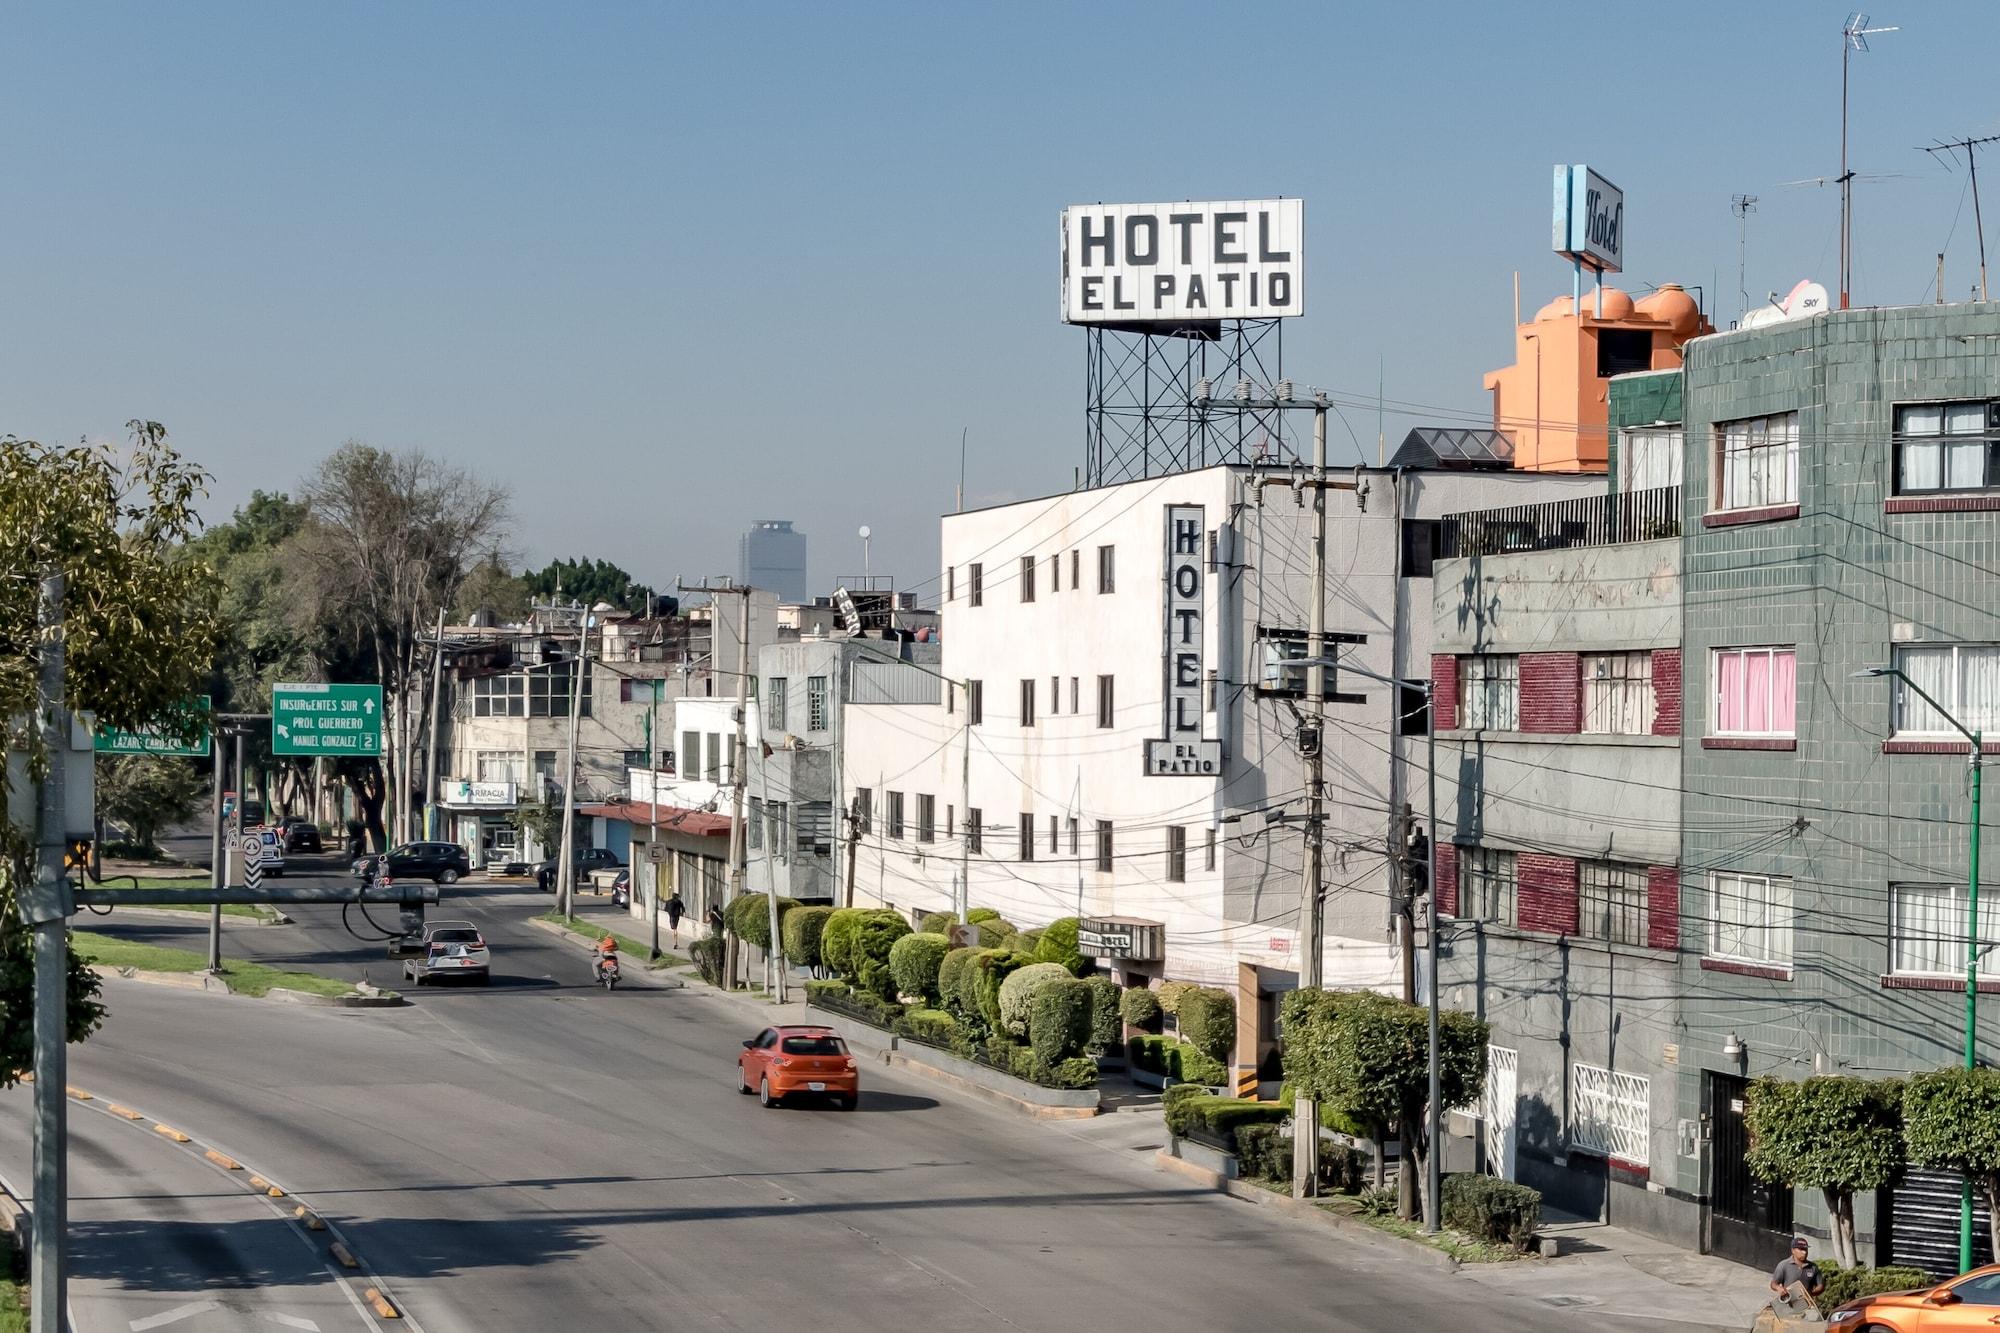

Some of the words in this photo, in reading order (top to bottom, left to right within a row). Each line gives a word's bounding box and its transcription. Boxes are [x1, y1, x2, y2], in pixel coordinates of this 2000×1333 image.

[1586, 189, 1622, 255] Hotel
[1081, 211, 1291, 267] HOTEL
[1081, 275, 1136, 310] EL
[1153, 272, 1291, 310] PATIO
[1803, 299, 1819, 308] SKY
[1175, 519, 1200, 732] HOTEL
[280, 699, 337, 711] INSURGENTES
[341, 700, 358, 711] SUR
[293, 717, 314, 728] PROL
[318, 718, 363, 729] GUERRERO
[293, 735, 319, 747] MANUEL
[322, 735, 356, 747] GONZALEZ
[364, 736, 373, 748] 2
[1176, 745, 1196, 757] EL
[1159, 760, 1212, 772] PATIO
[458, 783, 505, 797] FARMACIA
